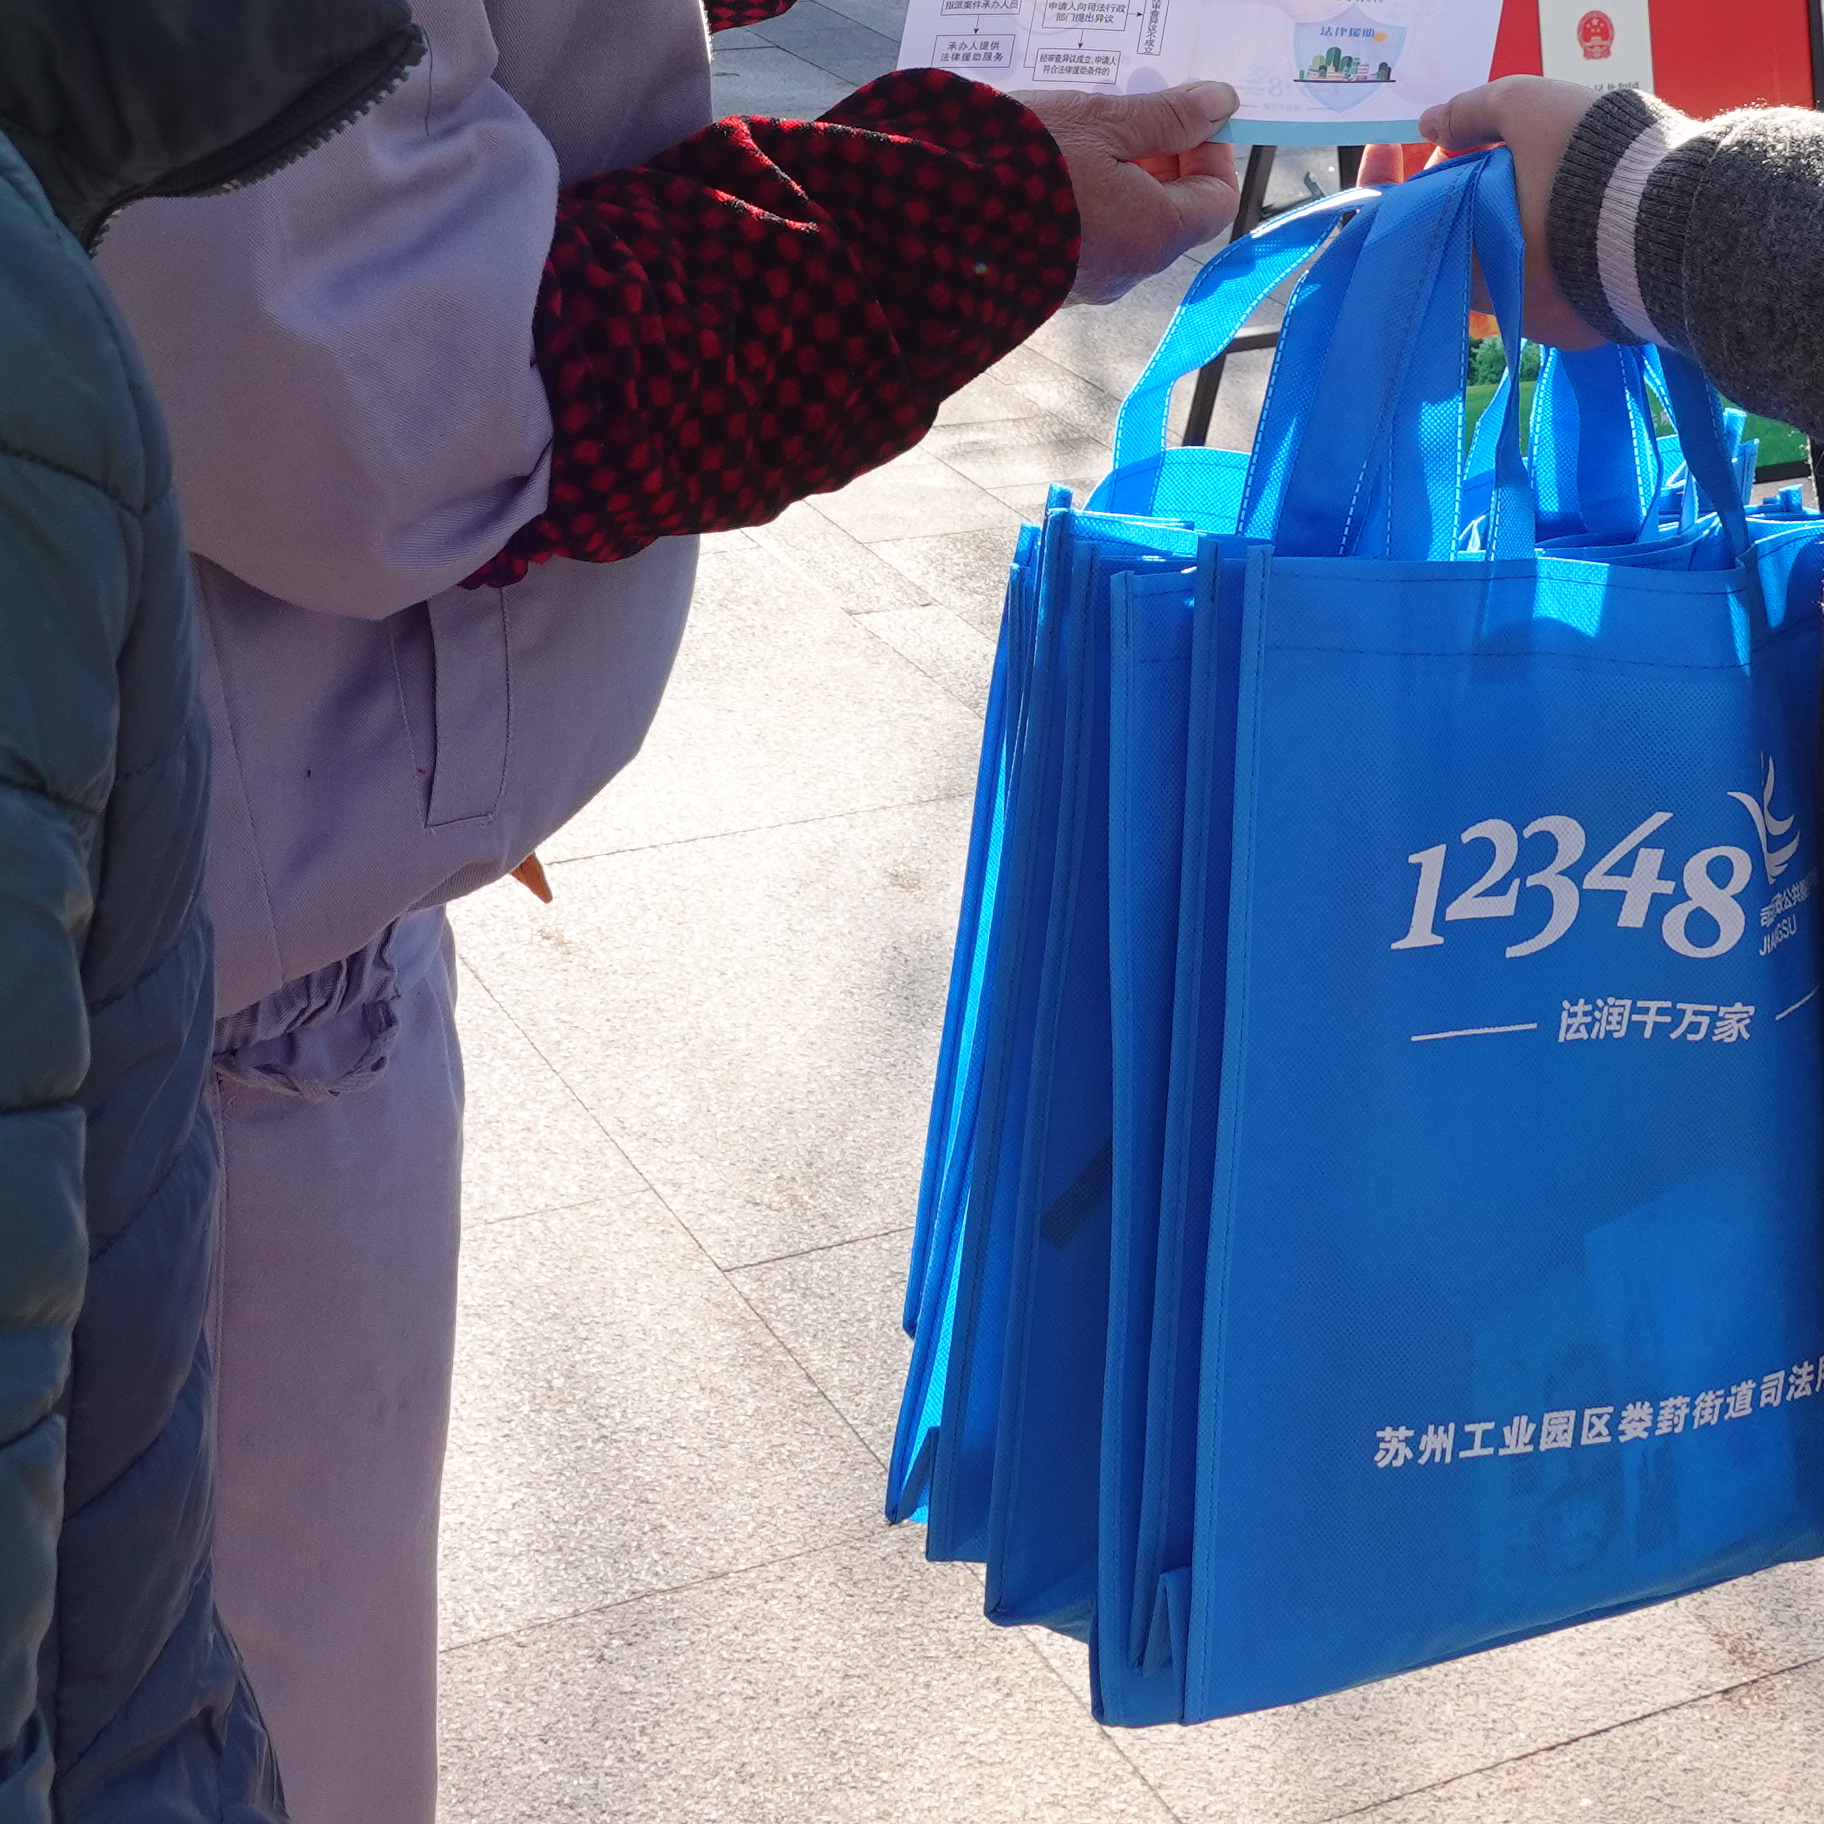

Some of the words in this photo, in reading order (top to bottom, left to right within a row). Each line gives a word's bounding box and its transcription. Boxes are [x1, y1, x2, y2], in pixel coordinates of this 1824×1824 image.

[1049, 2, 1127, 14] 申请人向司法行政
[1320, 25, 1375, 38] 法律援助
[947, 41, 1001, 52] 承办人提供
[940, 51, 1004, 63] 法律援助服务
[1391, 811, 1753, 959] 12348
[1558, 996, 1756, 1043] 法润千万家
